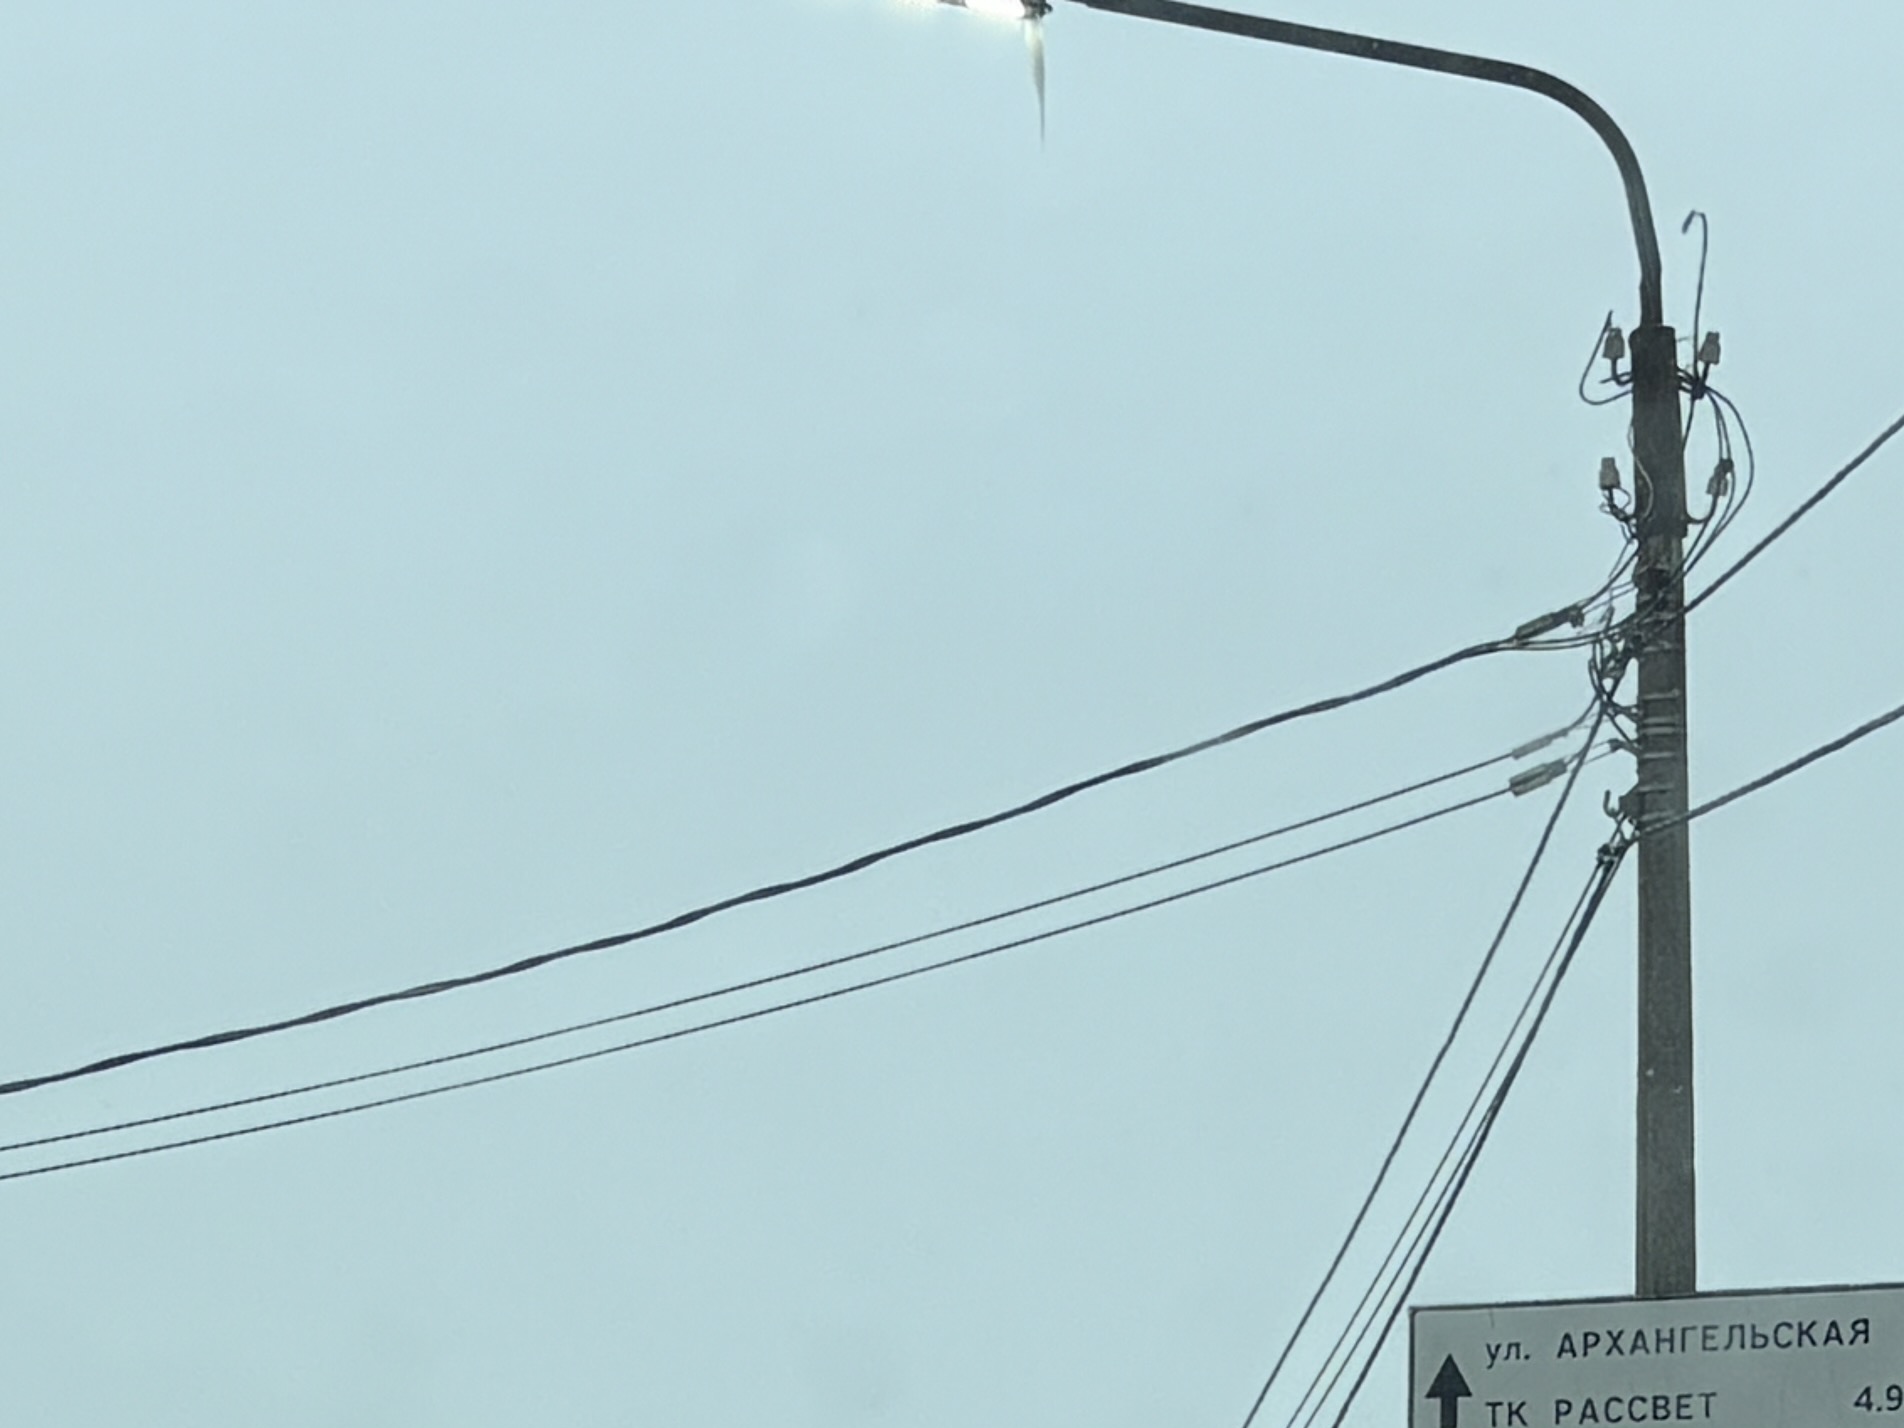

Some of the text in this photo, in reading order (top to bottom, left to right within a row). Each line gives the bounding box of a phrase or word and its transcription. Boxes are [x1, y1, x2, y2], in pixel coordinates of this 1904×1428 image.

[1486, 1317, 1871, 1370] ул. АРХАНГЕЛЬСКАЯ
[1486, 1391, 1718, 1428] ТК РАССВЕТ
[1853, 1384, 1904, 1414] 4.9
